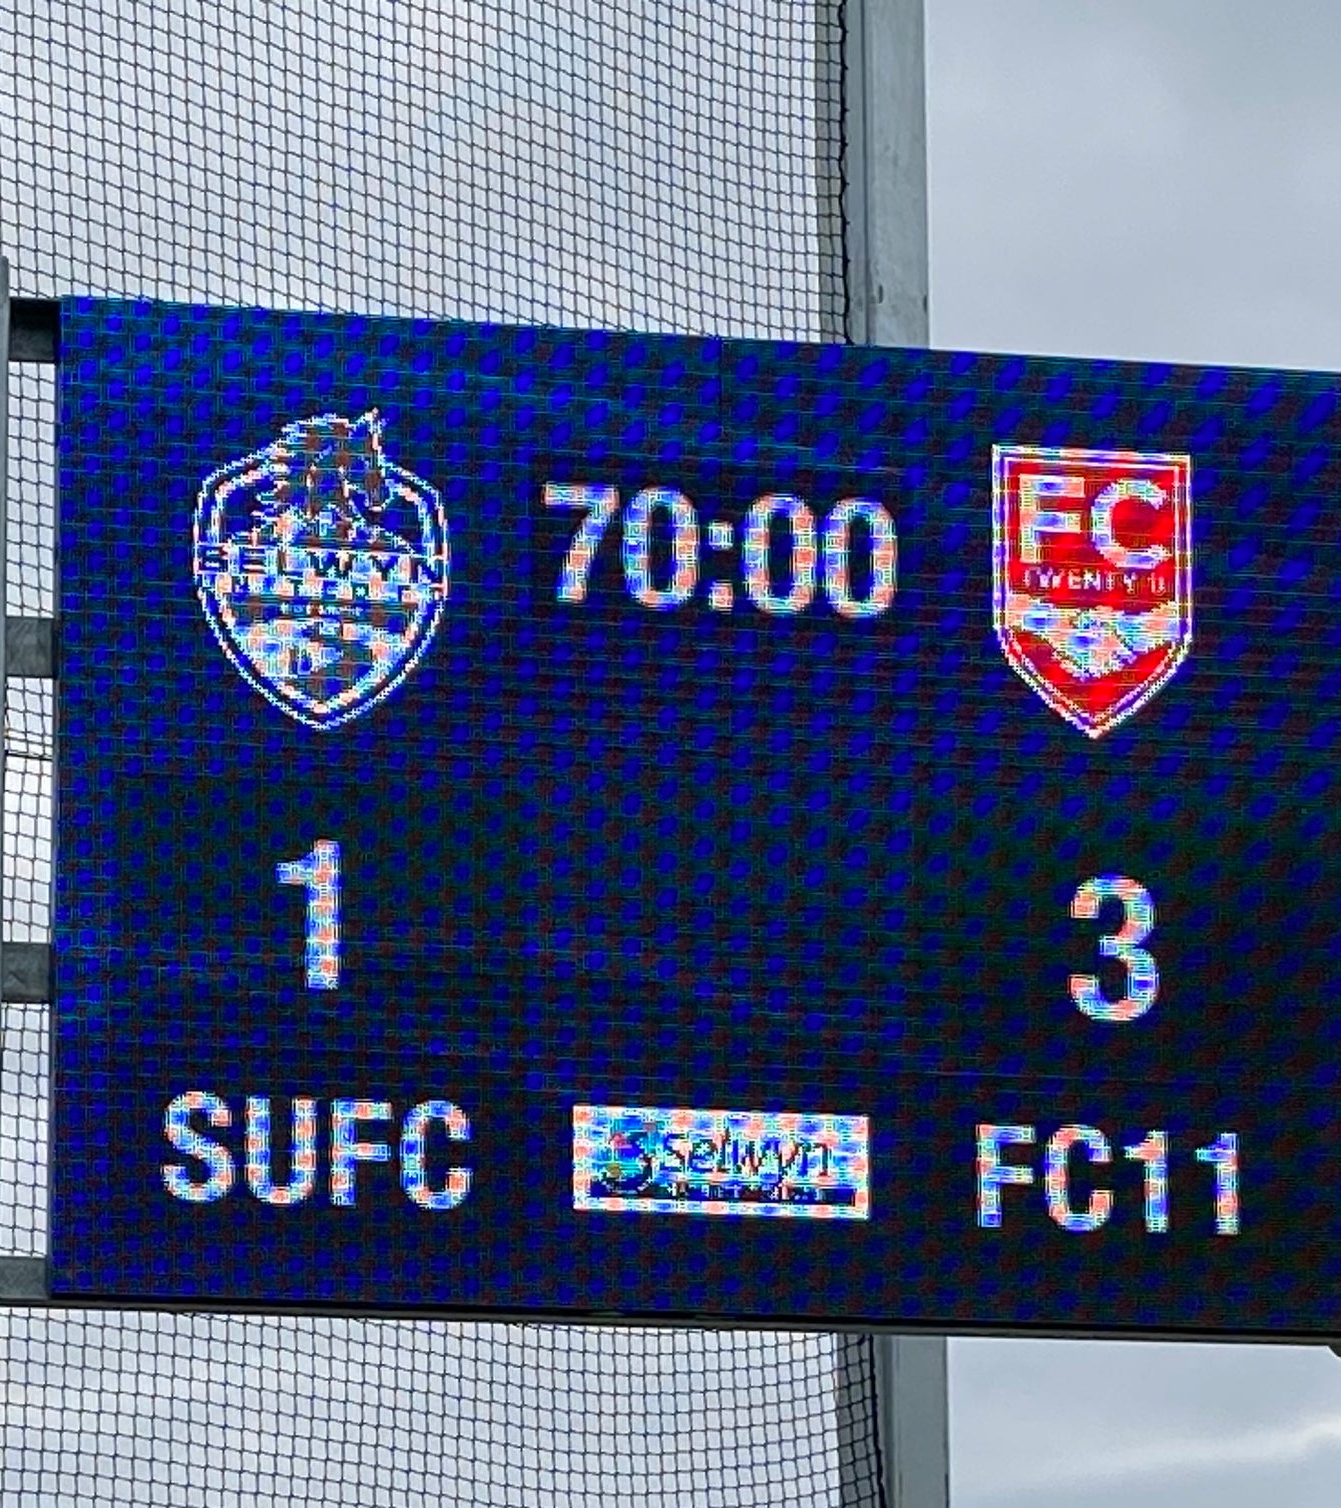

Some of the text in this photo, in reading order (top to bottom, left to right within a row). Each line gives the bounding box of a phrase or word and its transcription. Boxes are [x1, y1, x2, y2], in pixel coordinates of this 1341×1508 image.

[543, 482, 900, 618] 70:00
[1020, 473, 1172, 570] FC
[276, 840, 342, 989] 1
[1070, 876, 1160, 1021] 3
[162, 1092, 473, 1210] SUFC
[976, 1124, 1239, 1236] FC11
